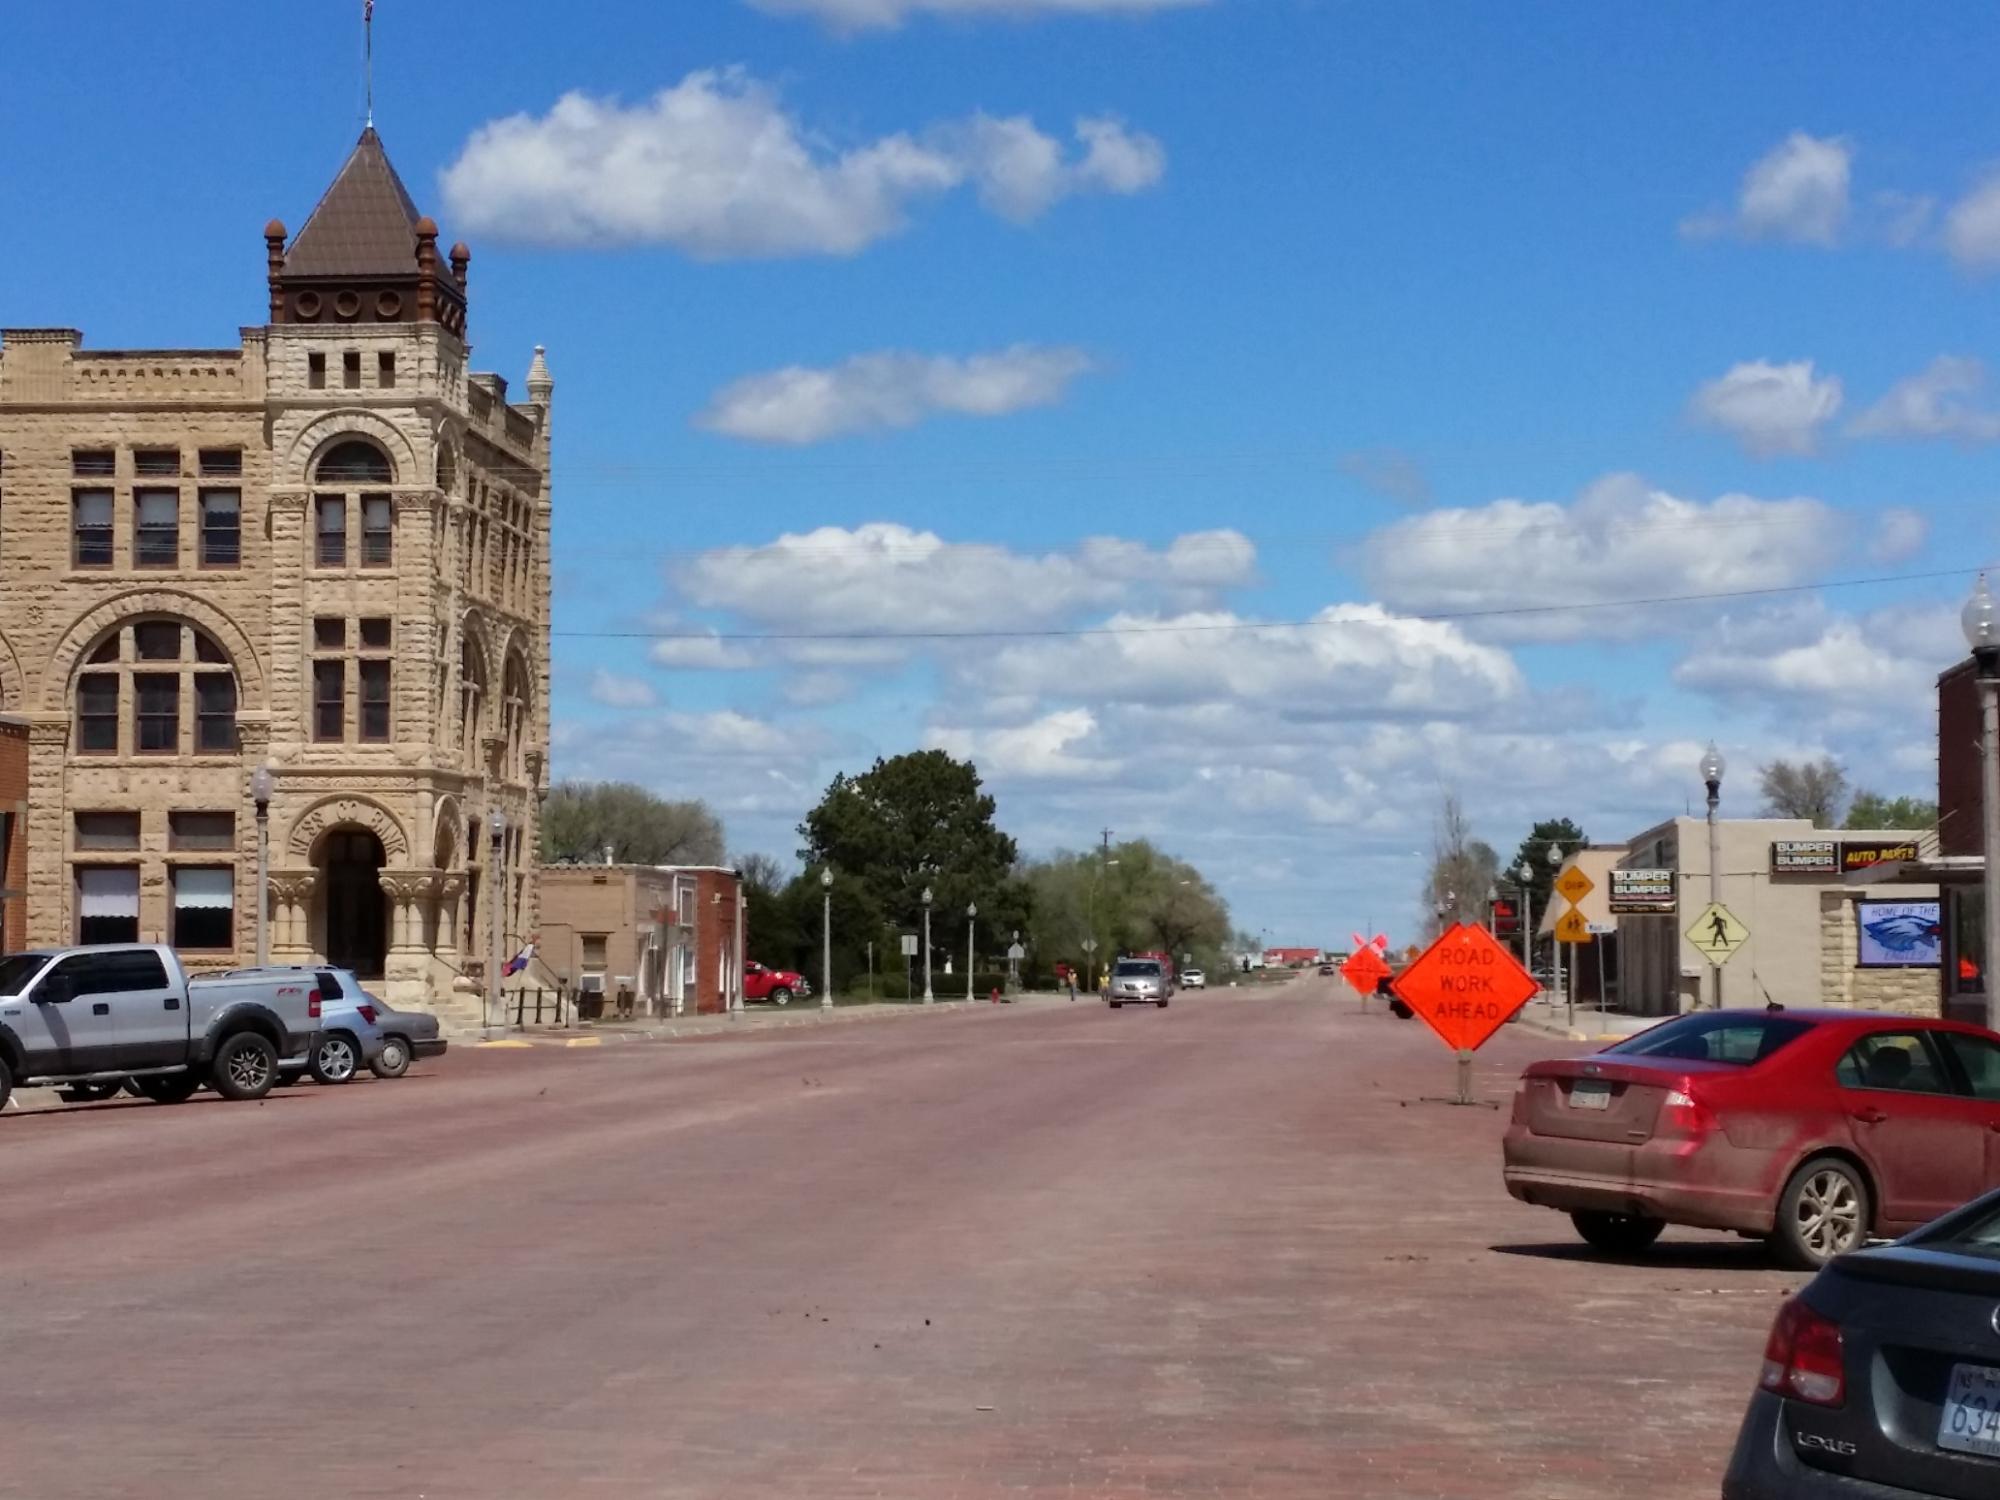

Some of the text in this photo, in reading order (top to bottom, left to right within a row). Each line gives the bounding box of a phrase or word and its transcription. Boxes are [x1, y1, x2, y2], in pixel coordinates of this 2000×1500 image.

[288, 811, 324, 856] NESS
[337, 800, 358, 821] CO
[370, 810, 406, 857] BANK
[1776, 842, 1834, 852] BUMPER
[1846, 847, 1915, 863] AUTO PARTS
[1776, 856, 1834, 865] BUMPER
[1614, 871, 1670, 881] BUMPER
[1614, 885, 1671, 894] BUMPER
[1919, 905, 1937, 916] THE
[1440, 948, 1495, 965] ROAD
[1440, 975, 1495, 992] WORK
[1435, 1002, 1499, 1019] AHEAD
[1796, 1430, 1857, 1456] LEXUS
